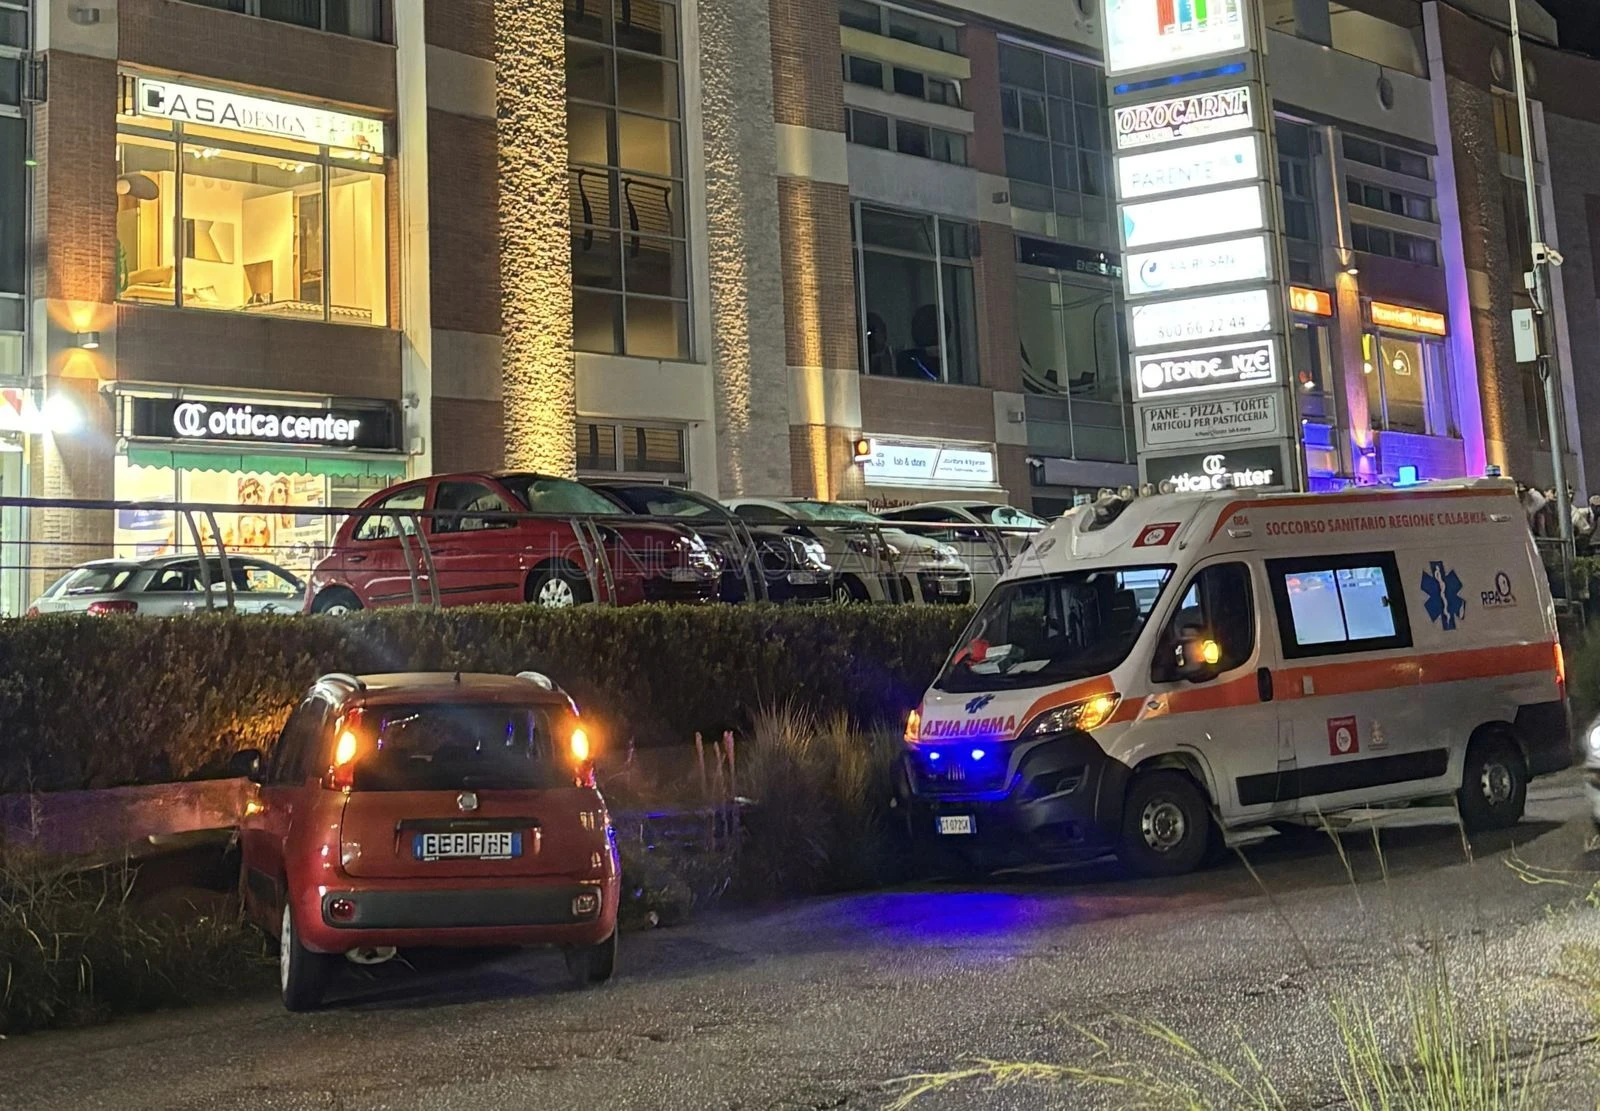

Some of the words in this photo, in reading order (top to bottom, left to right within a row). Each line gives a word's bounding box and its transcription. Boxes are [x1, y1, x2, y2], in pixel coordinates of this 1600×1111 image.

[1150, 407, 1180, 421] PANE
[1190, 403, 1223, 417] PIZZA
[1232, 397, 1270, 413] TORTE
[1151, 418, 1191, 432] ARTICOLI
[1194, 417, 1211, 428] PER
[1213, 410, 1268, 425] PASTICCERIA
[209, 406, 279, 437] ottica
[281, 413, 360, 440] center
[1265, 519, 1325, 537] SOCCORSO
[1328, 515, 1386, 533] SANITARIO
[1389, 513, 1436, 529] REGIONE
[1437, 510, 1488, 525] CALABRIA
